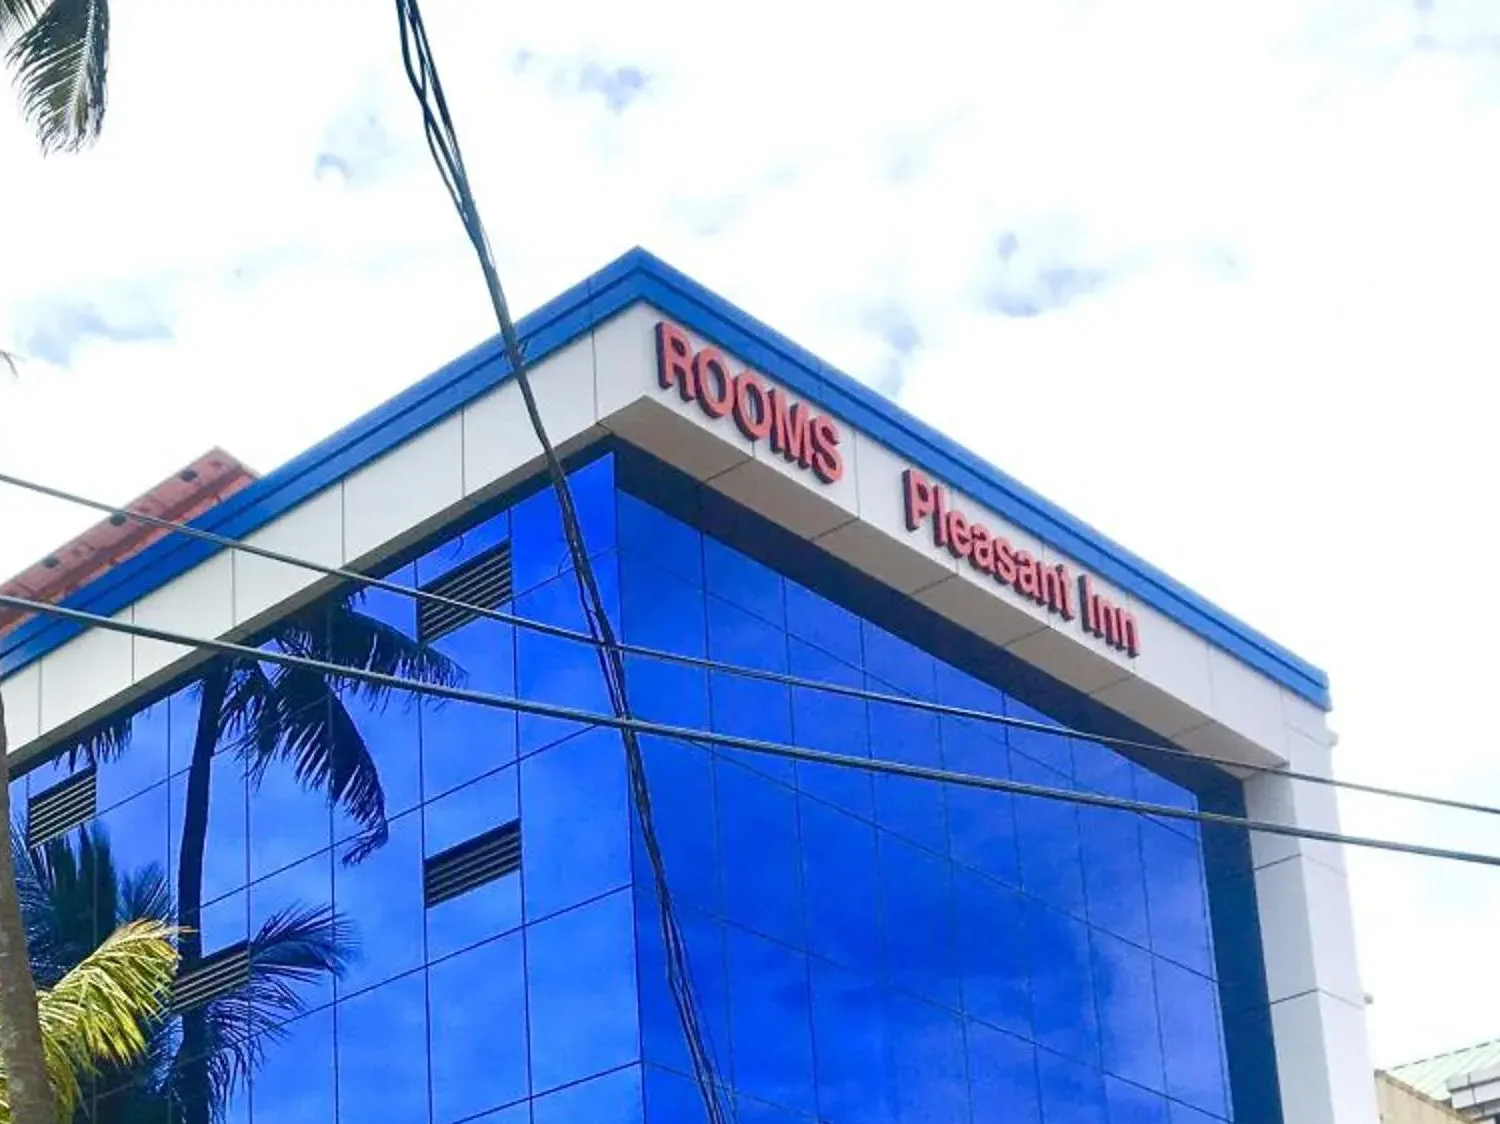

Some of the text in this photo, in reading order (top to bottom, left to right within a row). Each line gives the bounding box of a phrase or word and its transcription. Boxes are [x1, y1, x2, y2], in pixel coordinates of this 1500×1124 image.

[656, 320, 1140, 658] ROOMS Pleasant Inn
